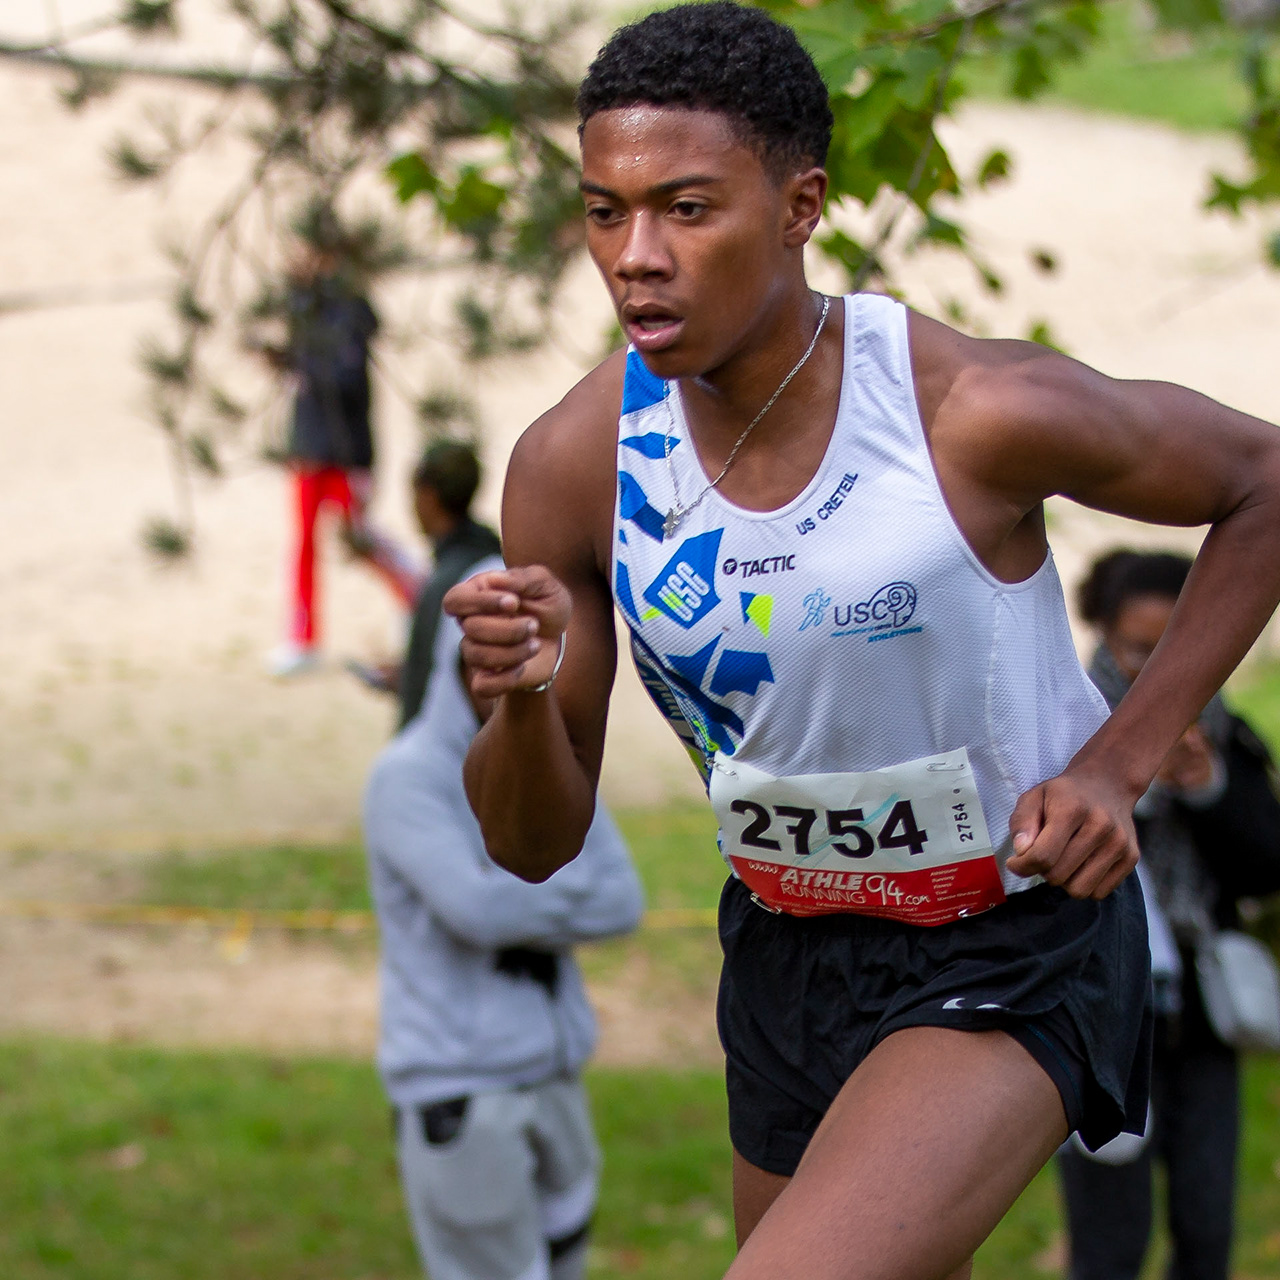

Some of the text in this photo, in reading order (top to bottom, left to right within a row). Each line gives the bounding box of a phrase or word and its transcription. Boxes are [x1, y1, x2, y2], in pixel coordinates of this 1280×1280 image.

[795, 473, 859, 535] US CRETEIL
[739, 554, 796, 578] TACTIC
[657, 561, 711, 622] USC
[834, 600, 889, 626] USC
[730, 799, 928, 859] 2754
[951, 801, 974, 843] 2754
[780, 868, 865, 891] ATHLE
[780, 882, 867, 905] RUNNING
